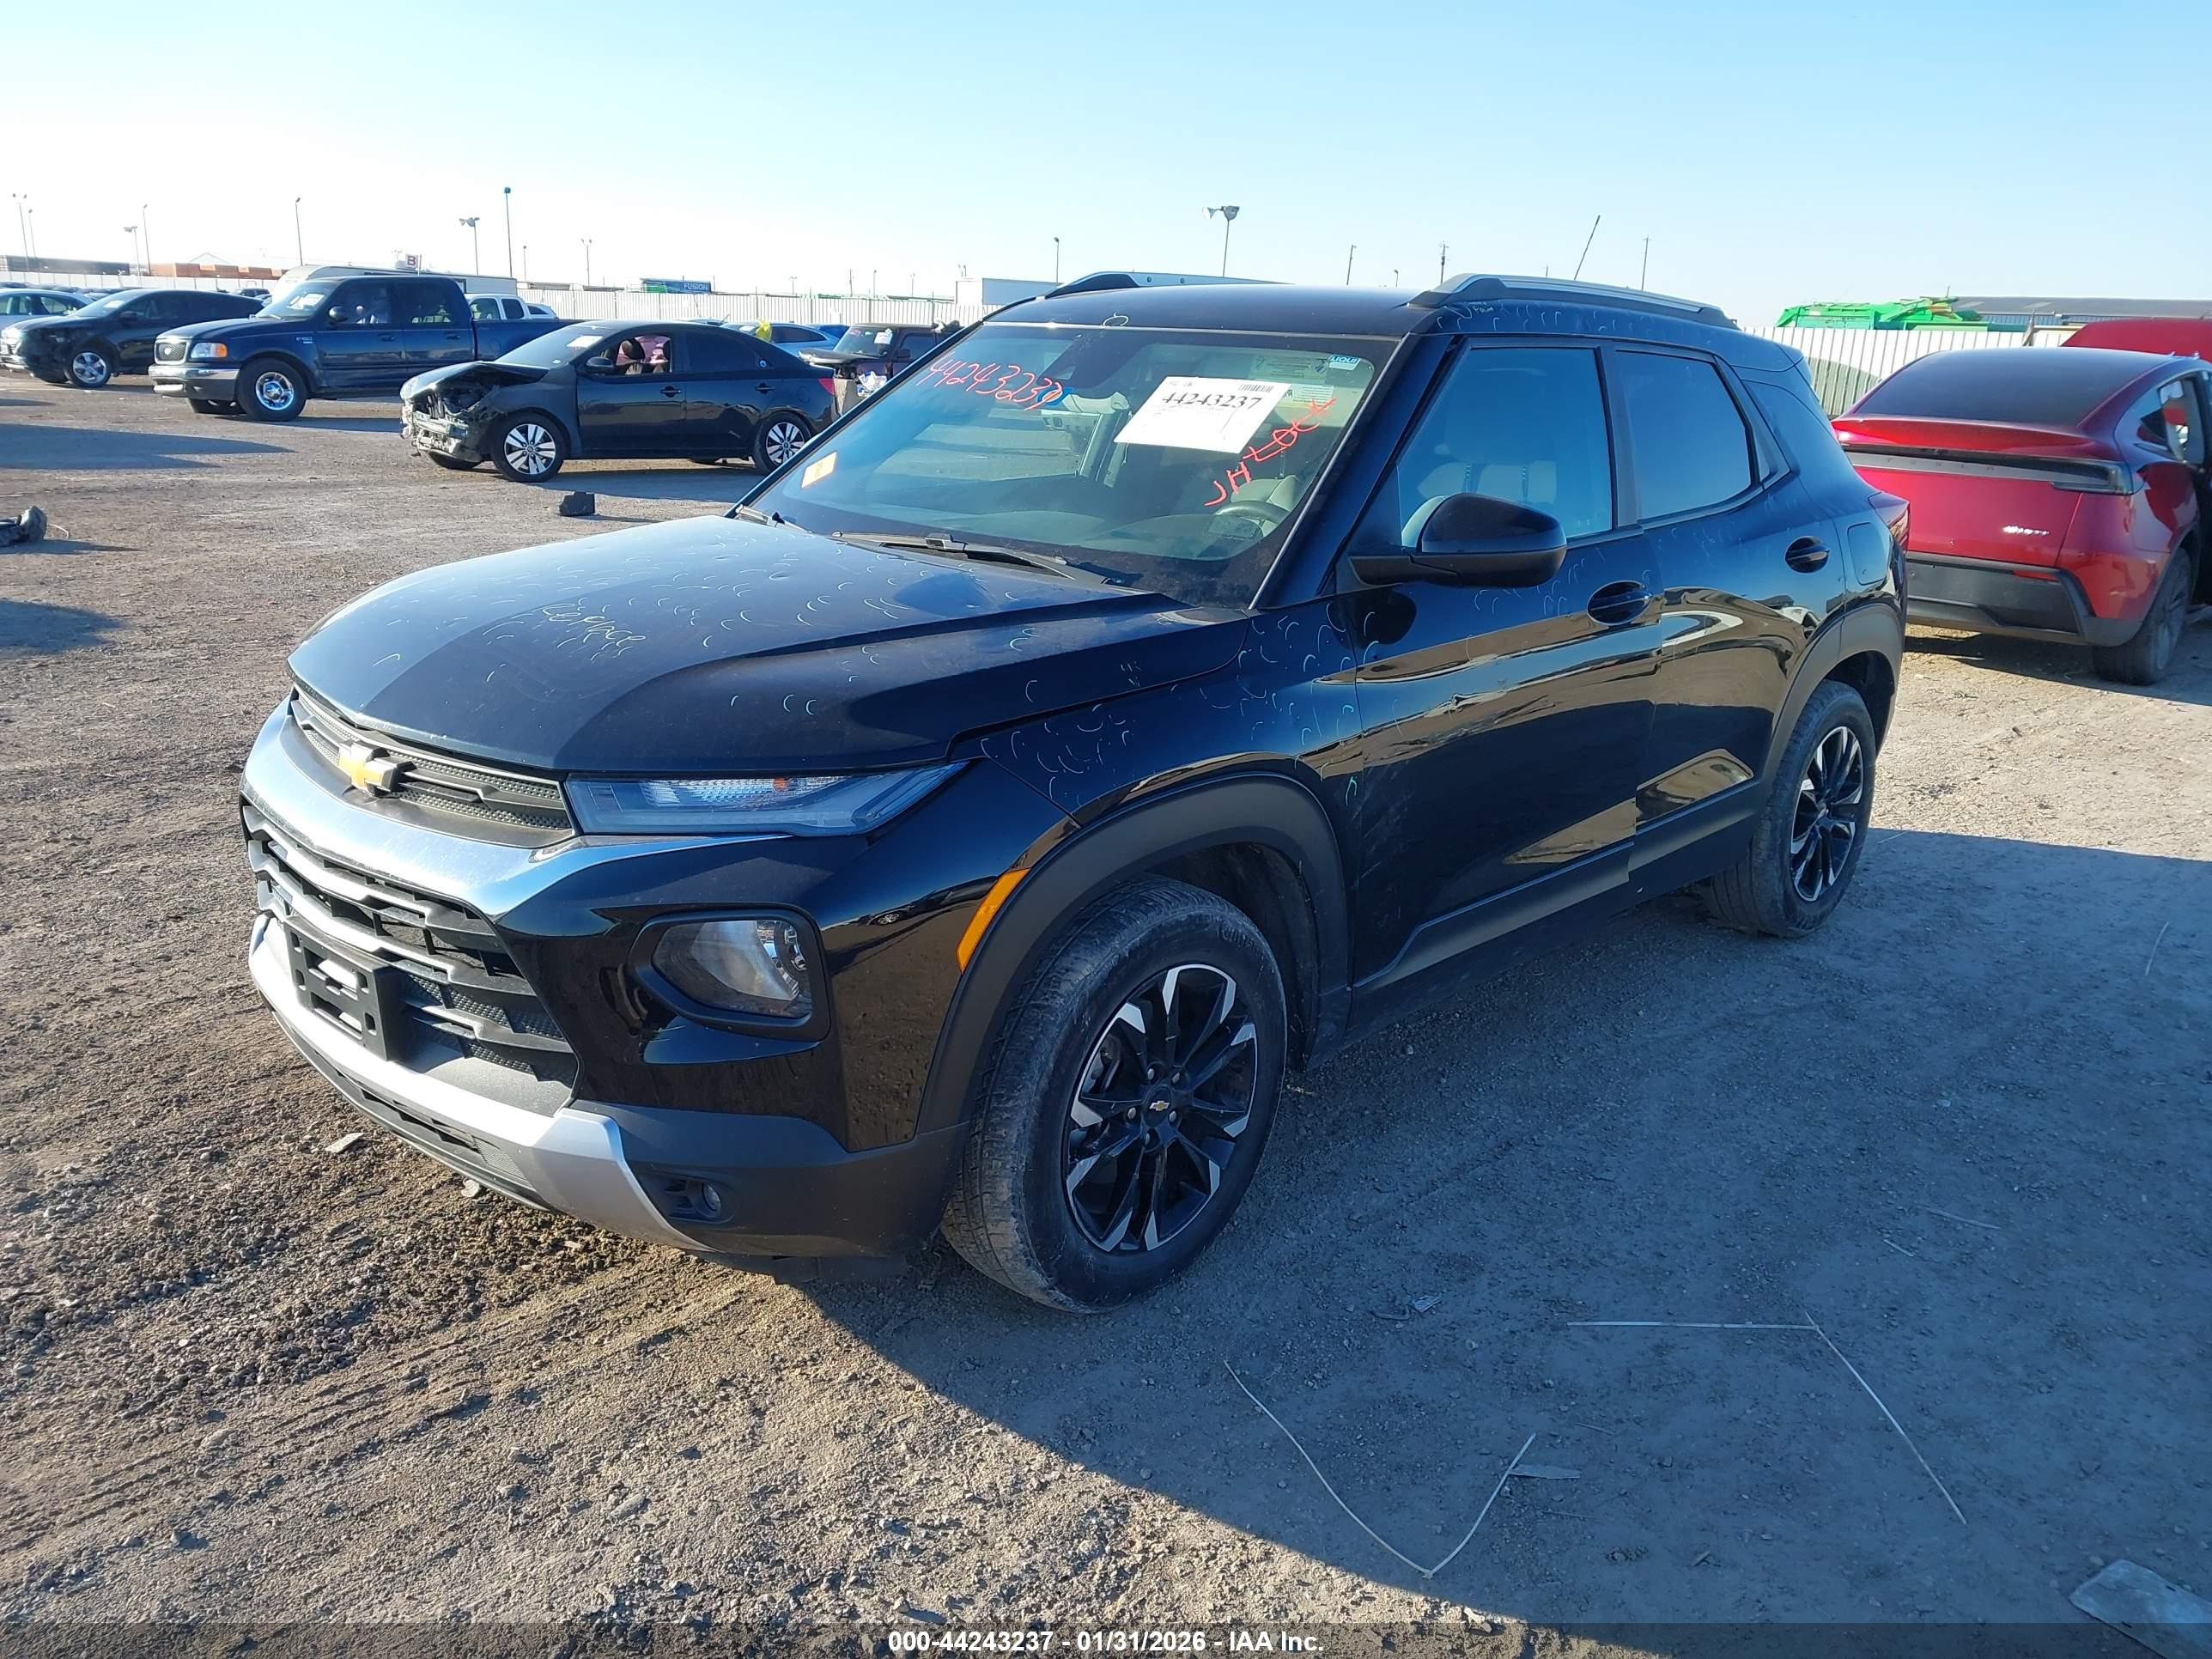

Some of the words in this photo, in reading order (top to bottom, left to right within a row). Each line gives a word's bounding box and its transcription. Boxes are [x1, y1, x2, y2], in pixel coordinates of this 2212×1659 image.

[407, 256, 416, 265] B
[683, 282, 708, 291] FUSION
[1162, 391, 1265, 410] 44243237
